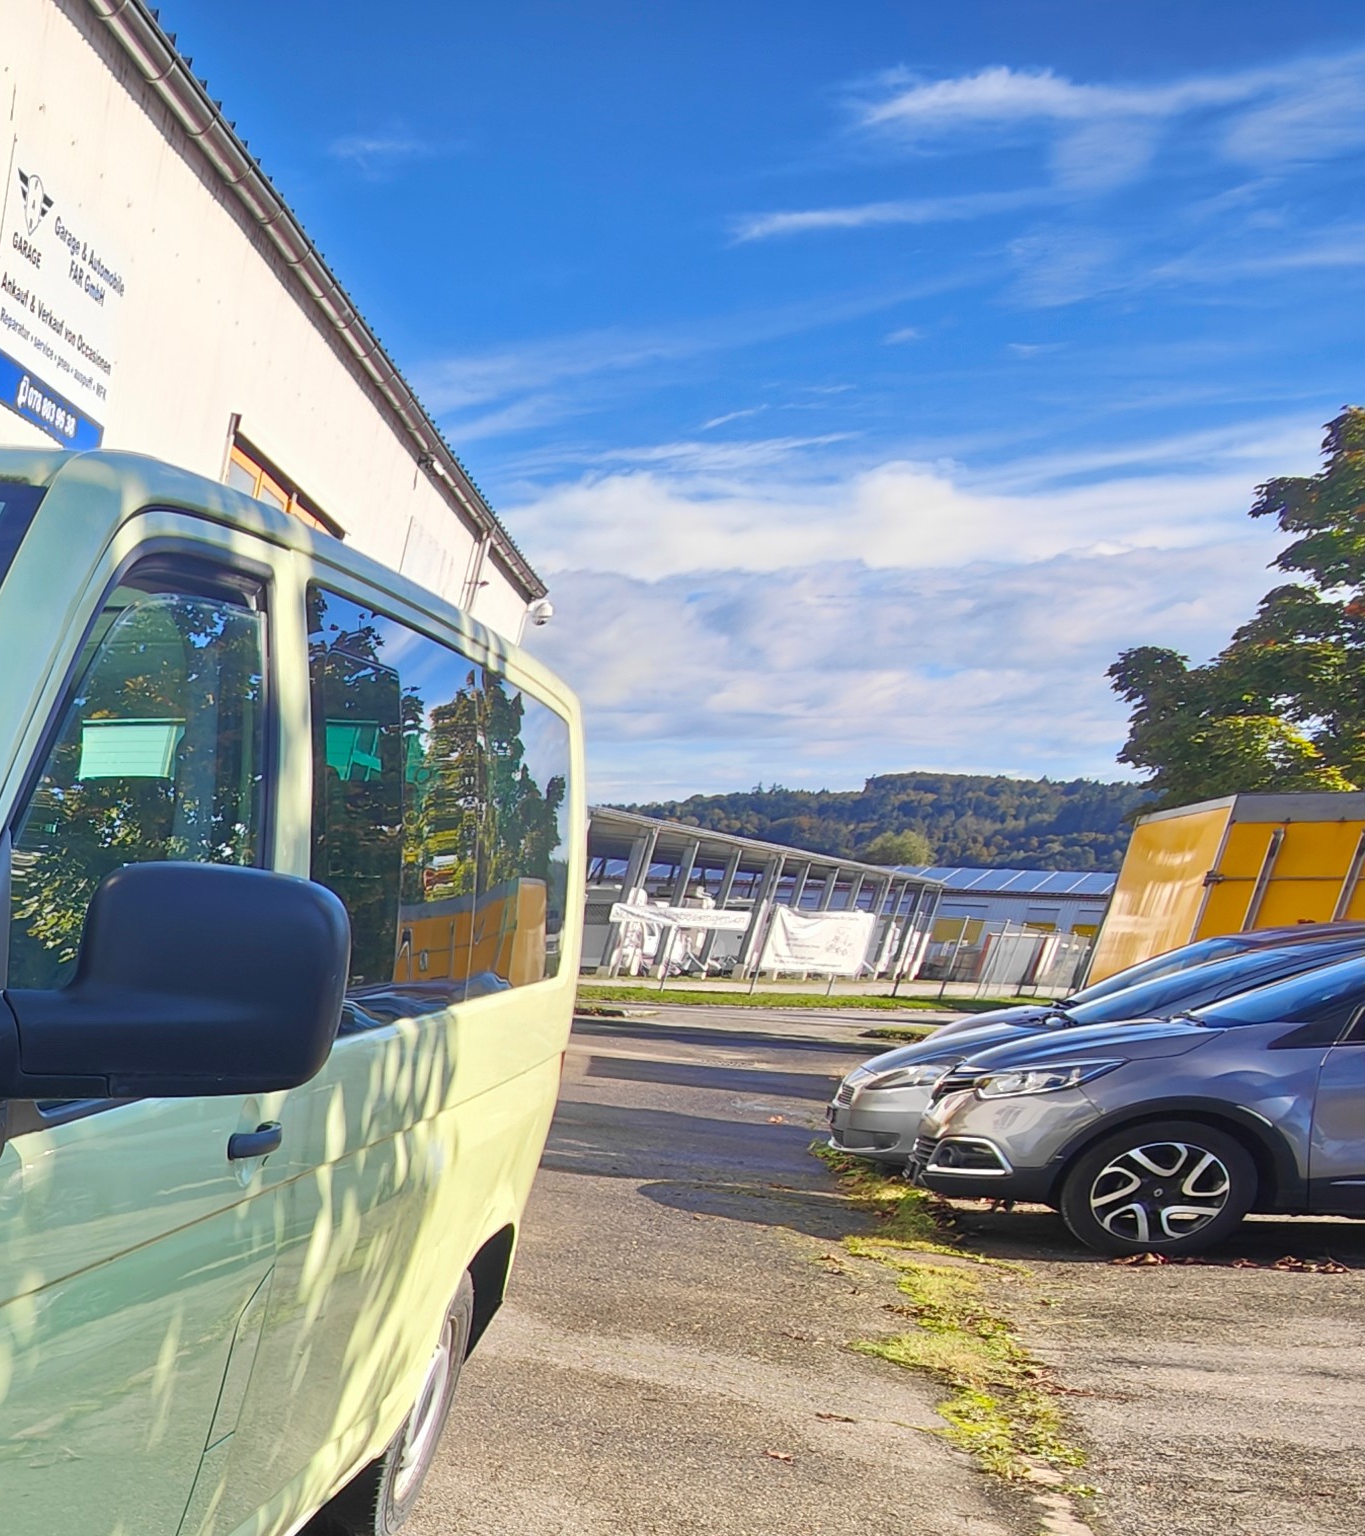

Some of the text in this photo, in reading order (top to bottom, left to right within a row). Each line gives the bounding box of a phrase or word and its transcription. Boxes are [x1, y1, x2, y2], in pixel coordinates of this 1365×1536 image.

[12, 231, 43, 270] GARAGE
[55, 216, 126, 298] Garage & Automobile
[68, 259, 106, 307] FAR GmbH
[0, 271, 112, 376] Ankauf & Verkauf von Occasionen
